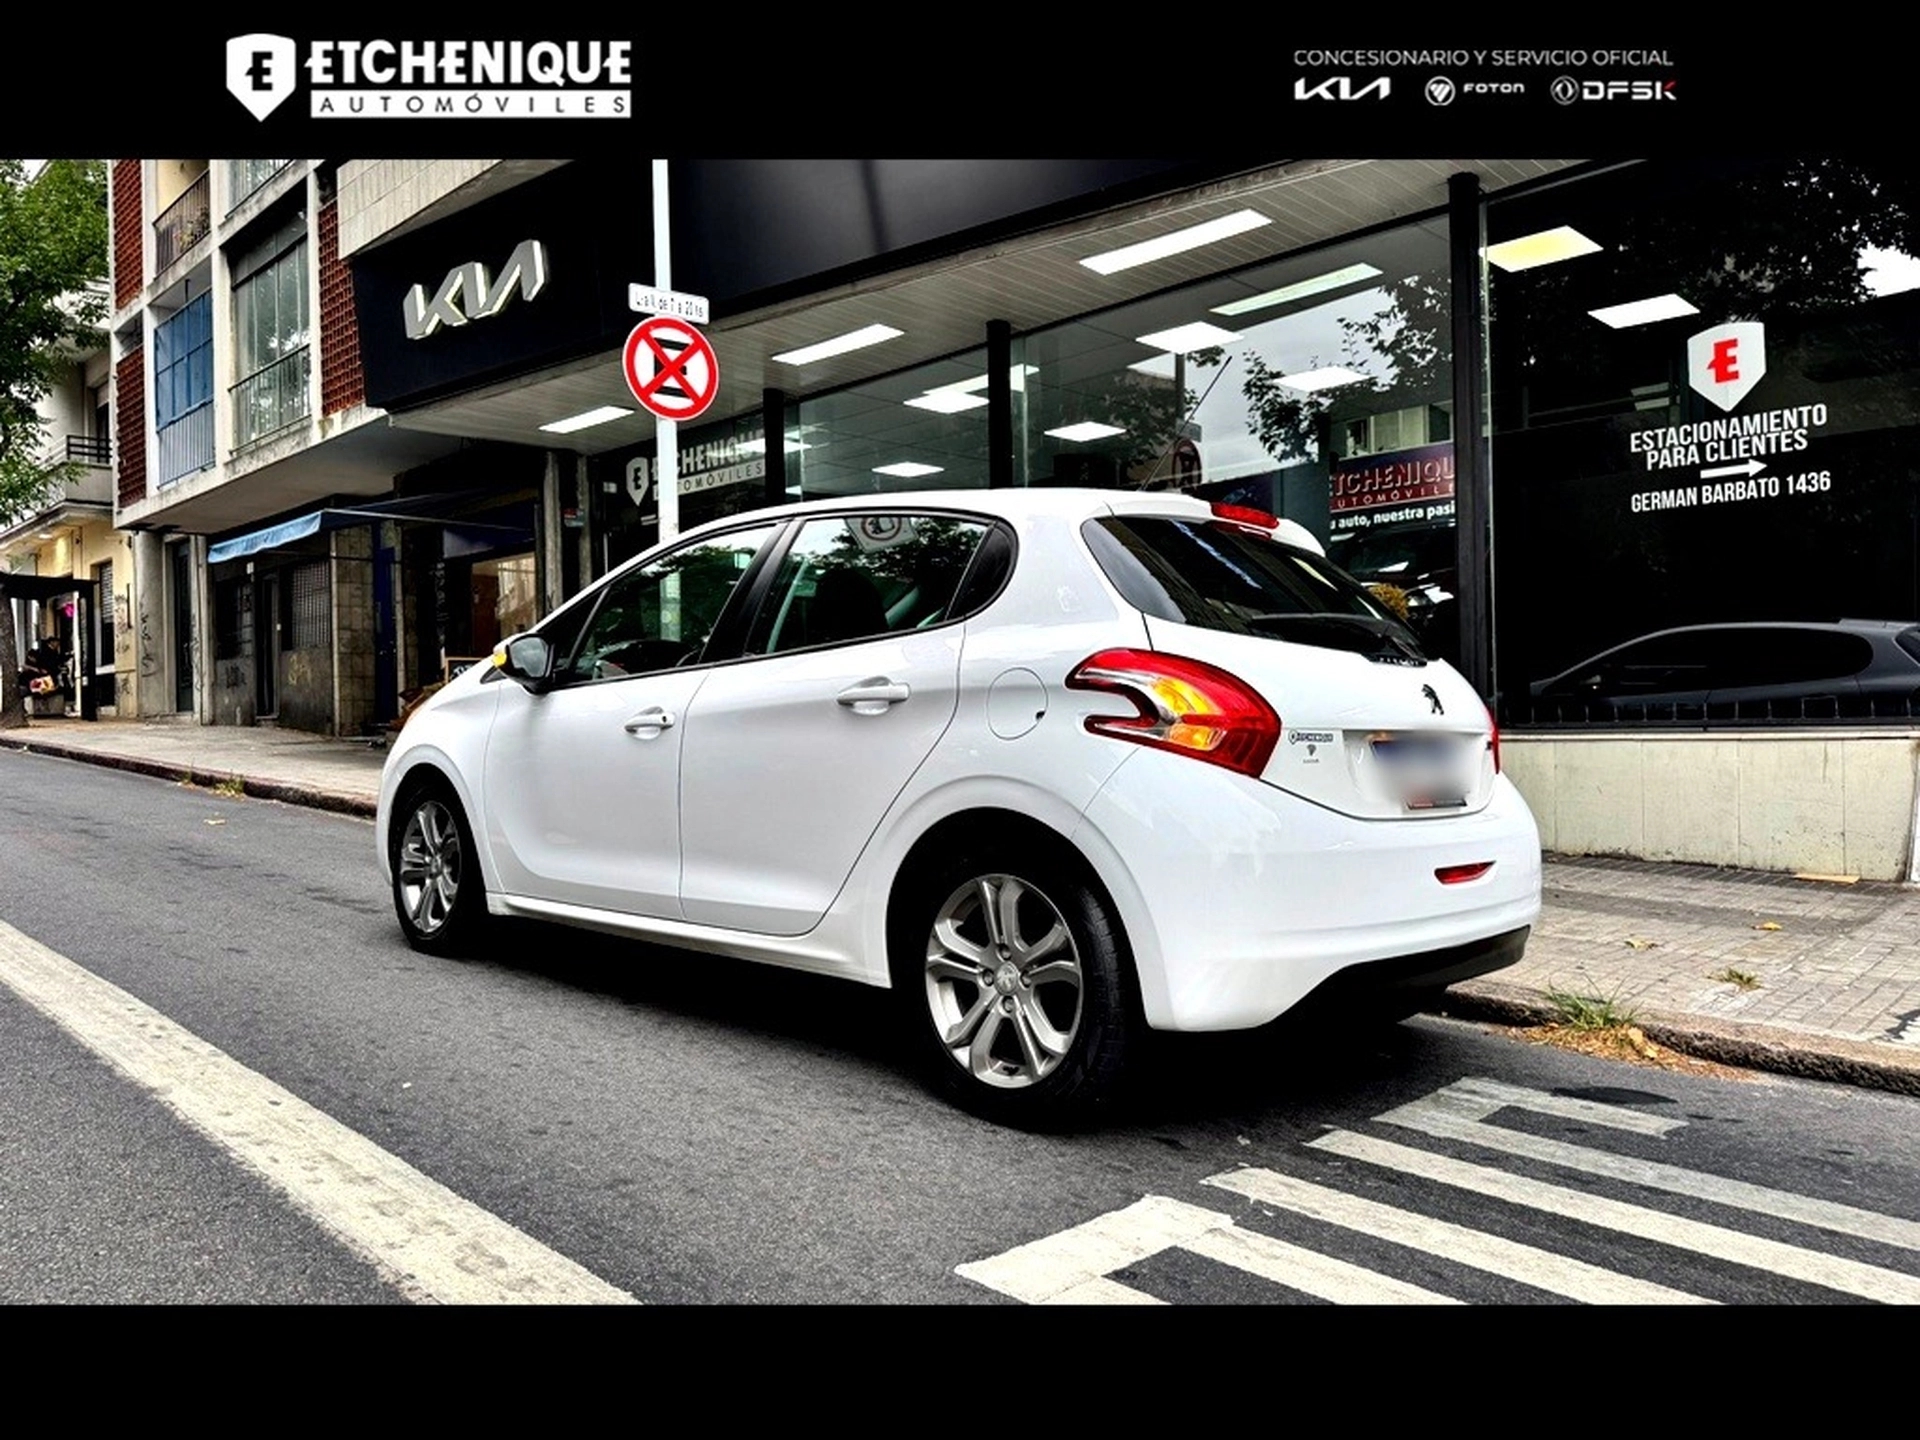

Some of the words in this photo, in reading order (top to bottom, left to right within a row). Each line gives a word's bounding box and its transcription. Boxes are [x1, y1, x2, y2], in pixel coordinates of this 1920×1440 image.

[403, 239, 545, 340] KIA
[1630, 404, 1827, 453] ESTACIONAMIENTO
[1646, 446, 1700, 471] PARA
[1705, 429, 1808, 462] CLIENTES
[1631, 487, 1697, 512] GERMAN
[1702, 477, 1779, 505] BARBATO
[1786, 471, 1831, 495] 1436
[1338, 514, 1371, 529] auto,
[1373, 506, 1424, 525] nuestra
